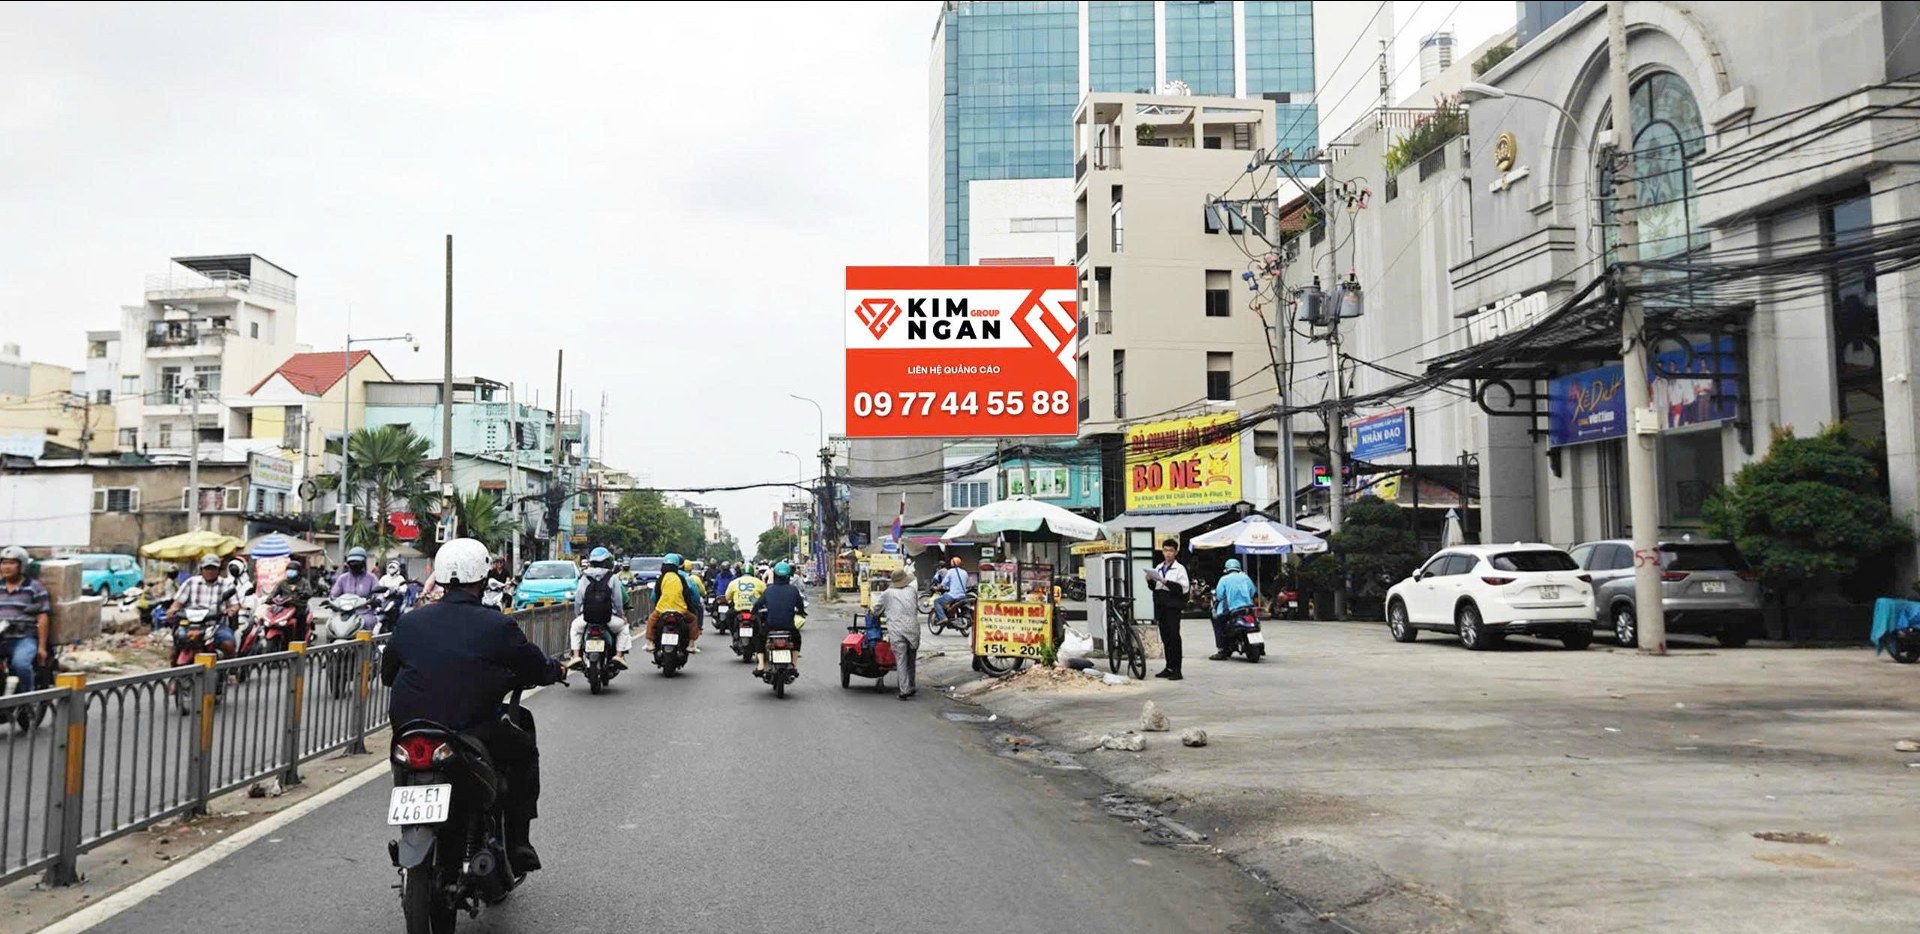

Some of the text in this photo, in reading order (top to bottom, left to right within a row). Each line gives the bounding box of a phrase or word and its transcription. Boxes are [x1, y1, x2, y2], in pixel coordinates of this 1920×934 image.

[908, 298, 1000, 318] KIM GROUP
[908, 320, 1001, 340] NGAN
[907, 363, 1001, 376] LIÊN HỆ QUẢNG CÁO
[854, 390, 1070, 416] 09 77 44 55 88
[1132, 453, 1202, 493] BÒ NÉ
[738, 579, 755, 592] be
[984, 603, 1045, 617] BÁNH MÌ
[984, 629, 1008, 641] XÔI
[983, 644, 1007, 654] 15k
[400, 788, 440, 804] 84-E1
